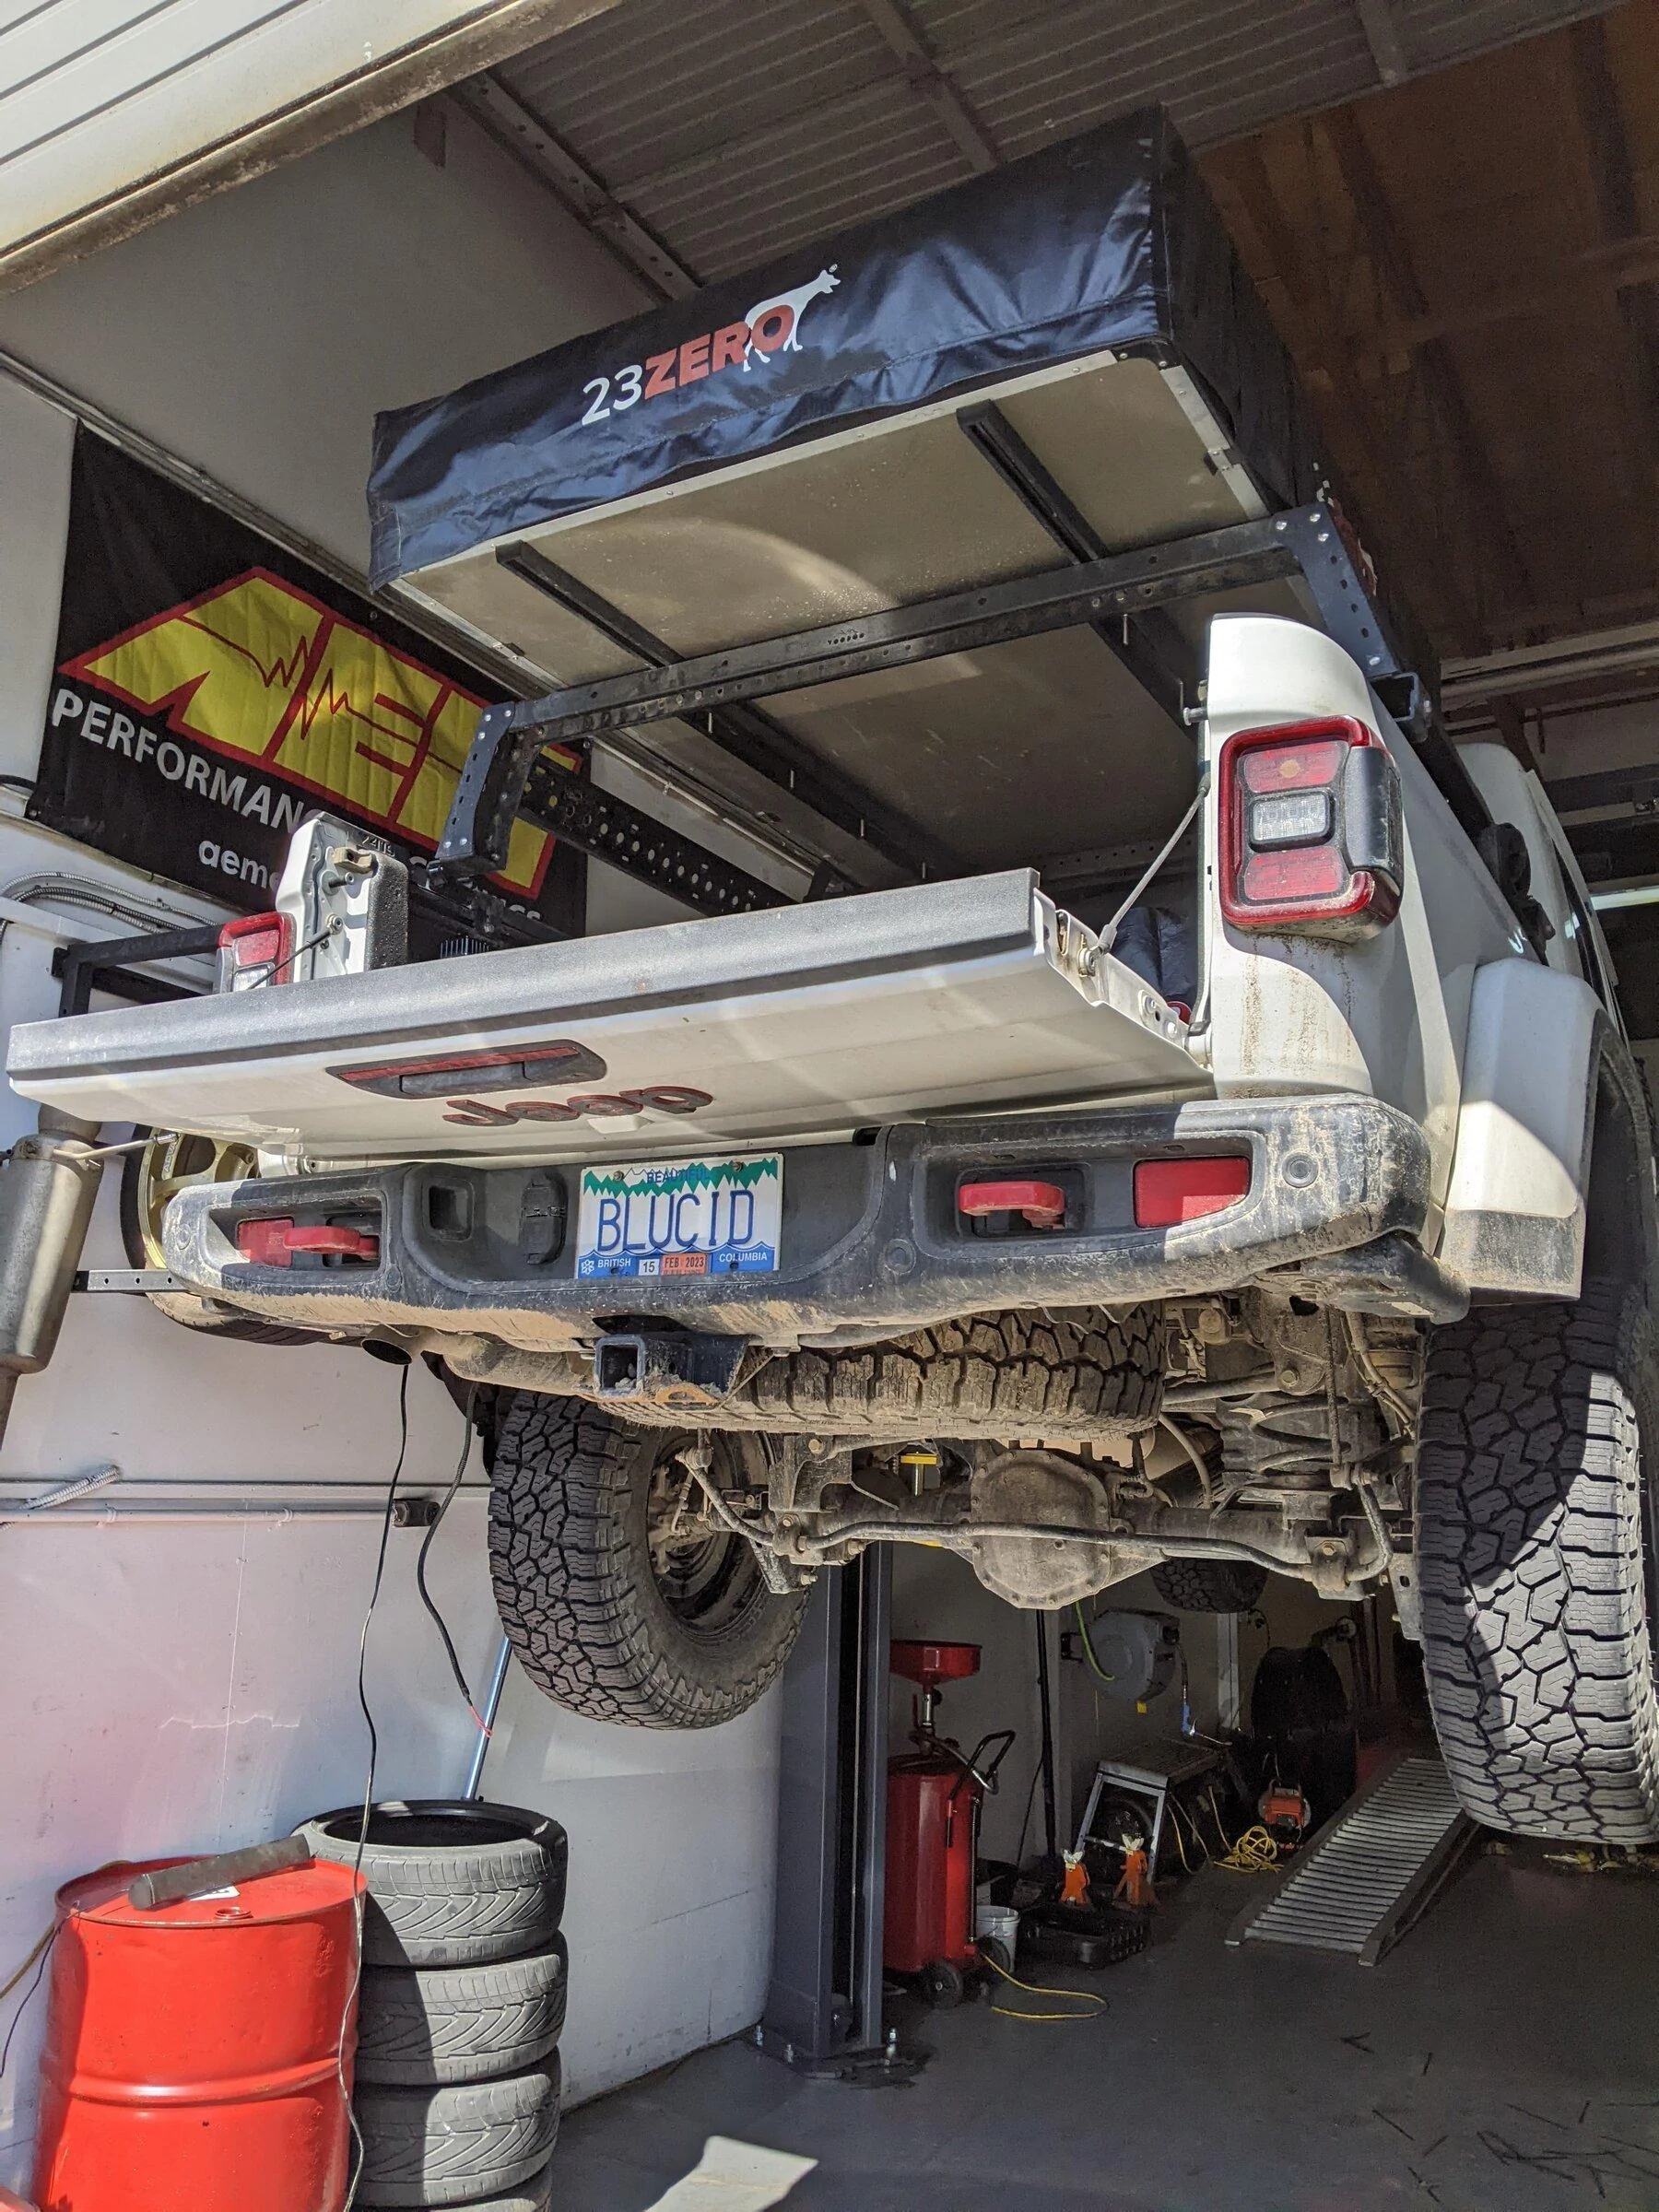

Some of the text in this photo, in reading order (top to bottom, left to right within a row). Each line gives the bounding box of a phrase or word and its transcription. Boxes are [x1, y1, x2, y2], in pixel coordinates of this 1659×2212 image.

[581, 304, 795, 426] 23ZERO
[51, 688, 322, 834] PERFORMAN
[441, 1086, 714, 1126] Jeep
[597, 1190, 755, 1252] BLUCID
[597, 1252, 768, 1268] BRITISH COLUMBIA
[642, 1261, 655, 1273] 15
[664, 1256, 704, 1268] FEB 2023
